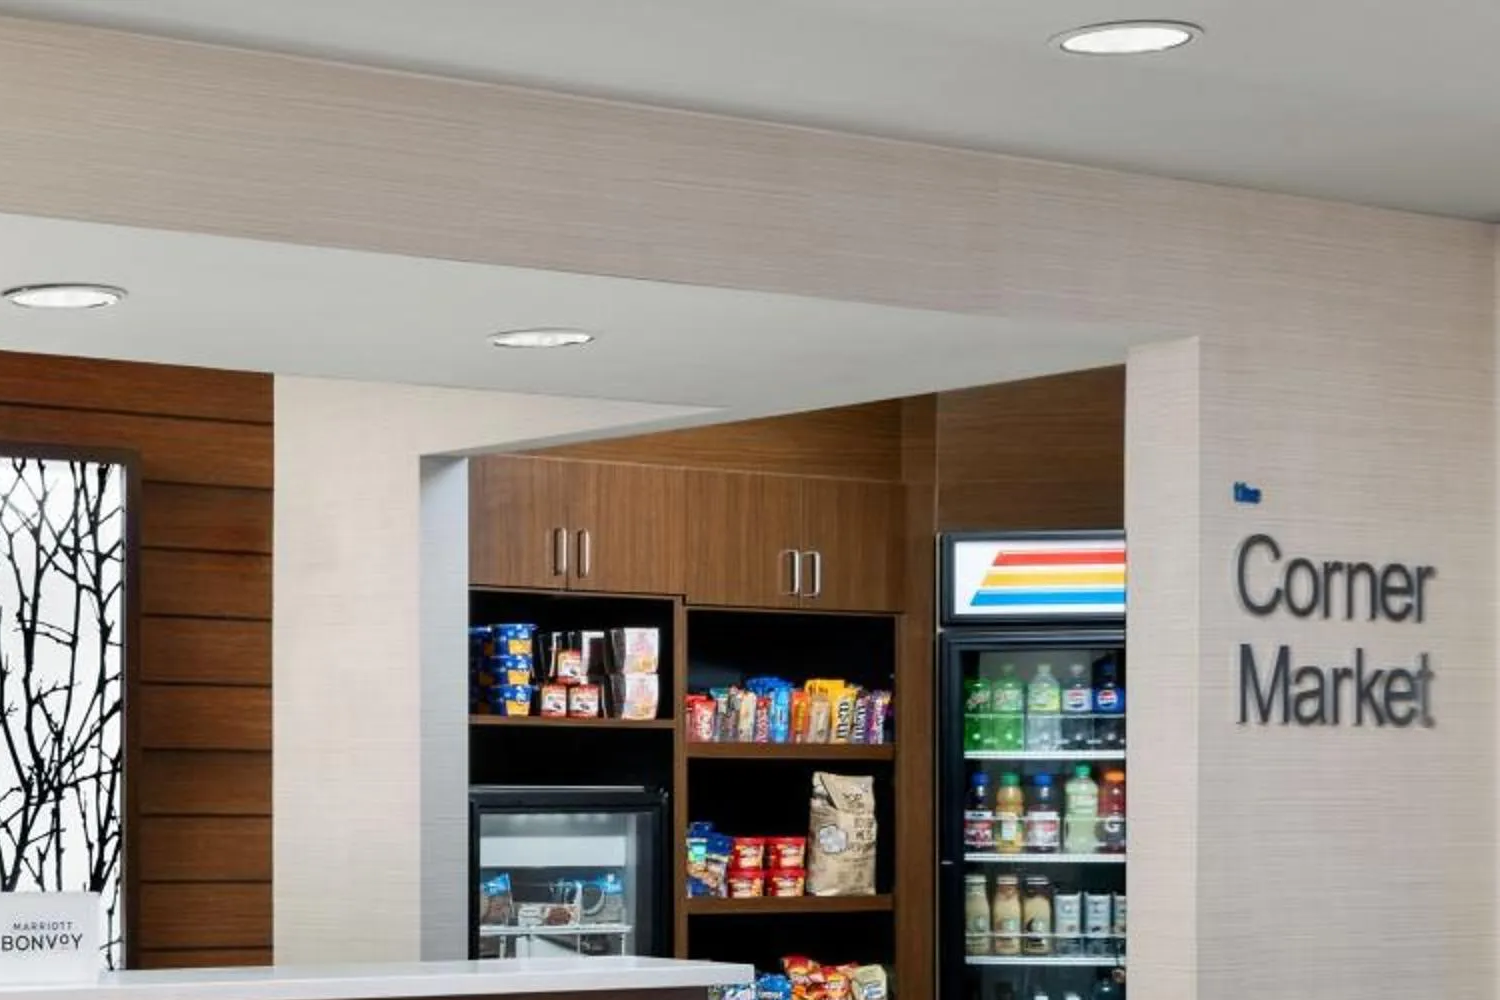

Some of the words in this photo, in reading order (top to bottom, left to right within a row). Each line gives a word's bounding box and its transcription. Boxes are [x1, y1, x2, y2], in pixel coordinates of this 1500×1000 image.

[1237, 533, 1438, 624] Corner
[1238, 643, 1436, 729] Market
[1, 933, 84, 952] BONVOY
[13, 921, 74, 932] MARRIOTT
